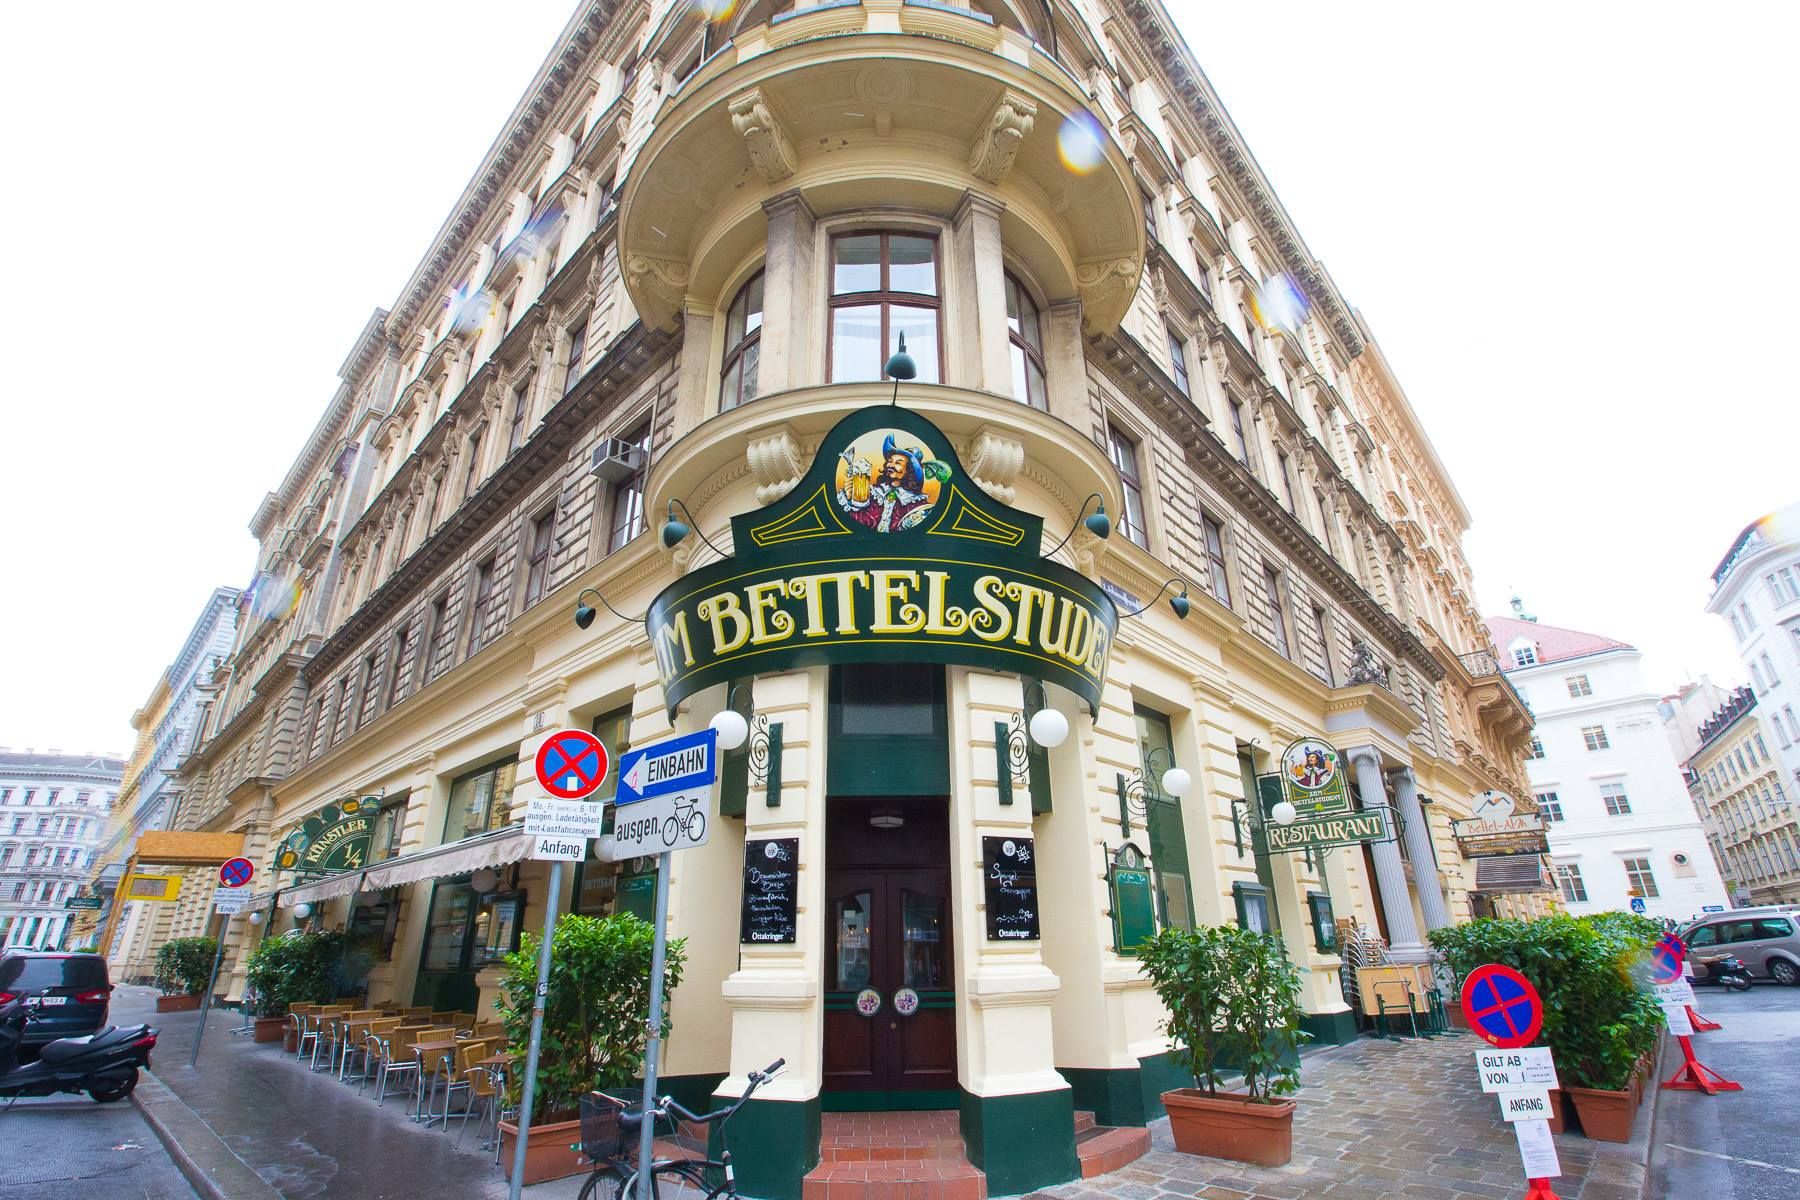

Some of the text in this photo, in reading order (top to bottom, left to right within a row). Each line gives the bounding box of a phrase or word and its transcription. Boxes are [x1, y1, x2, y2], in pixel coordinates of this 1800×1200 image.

[646, 747, 705, 783] EINBAHN
[616, 816, 662, 845] ausgen.
[1268, 814, 1382, 849] RESTAURANT
[306, 819, 367, 863] KÜNSTLER
[540, 839, 580, 858] Anfang
[751, 932, 785, 942] Ottakringer
[1483, 1055, 1522, 1068] GILT AB
[1485, 1072, 1509, 1085] VON
[1510, 1097, 1544, 1113] ANFANG
